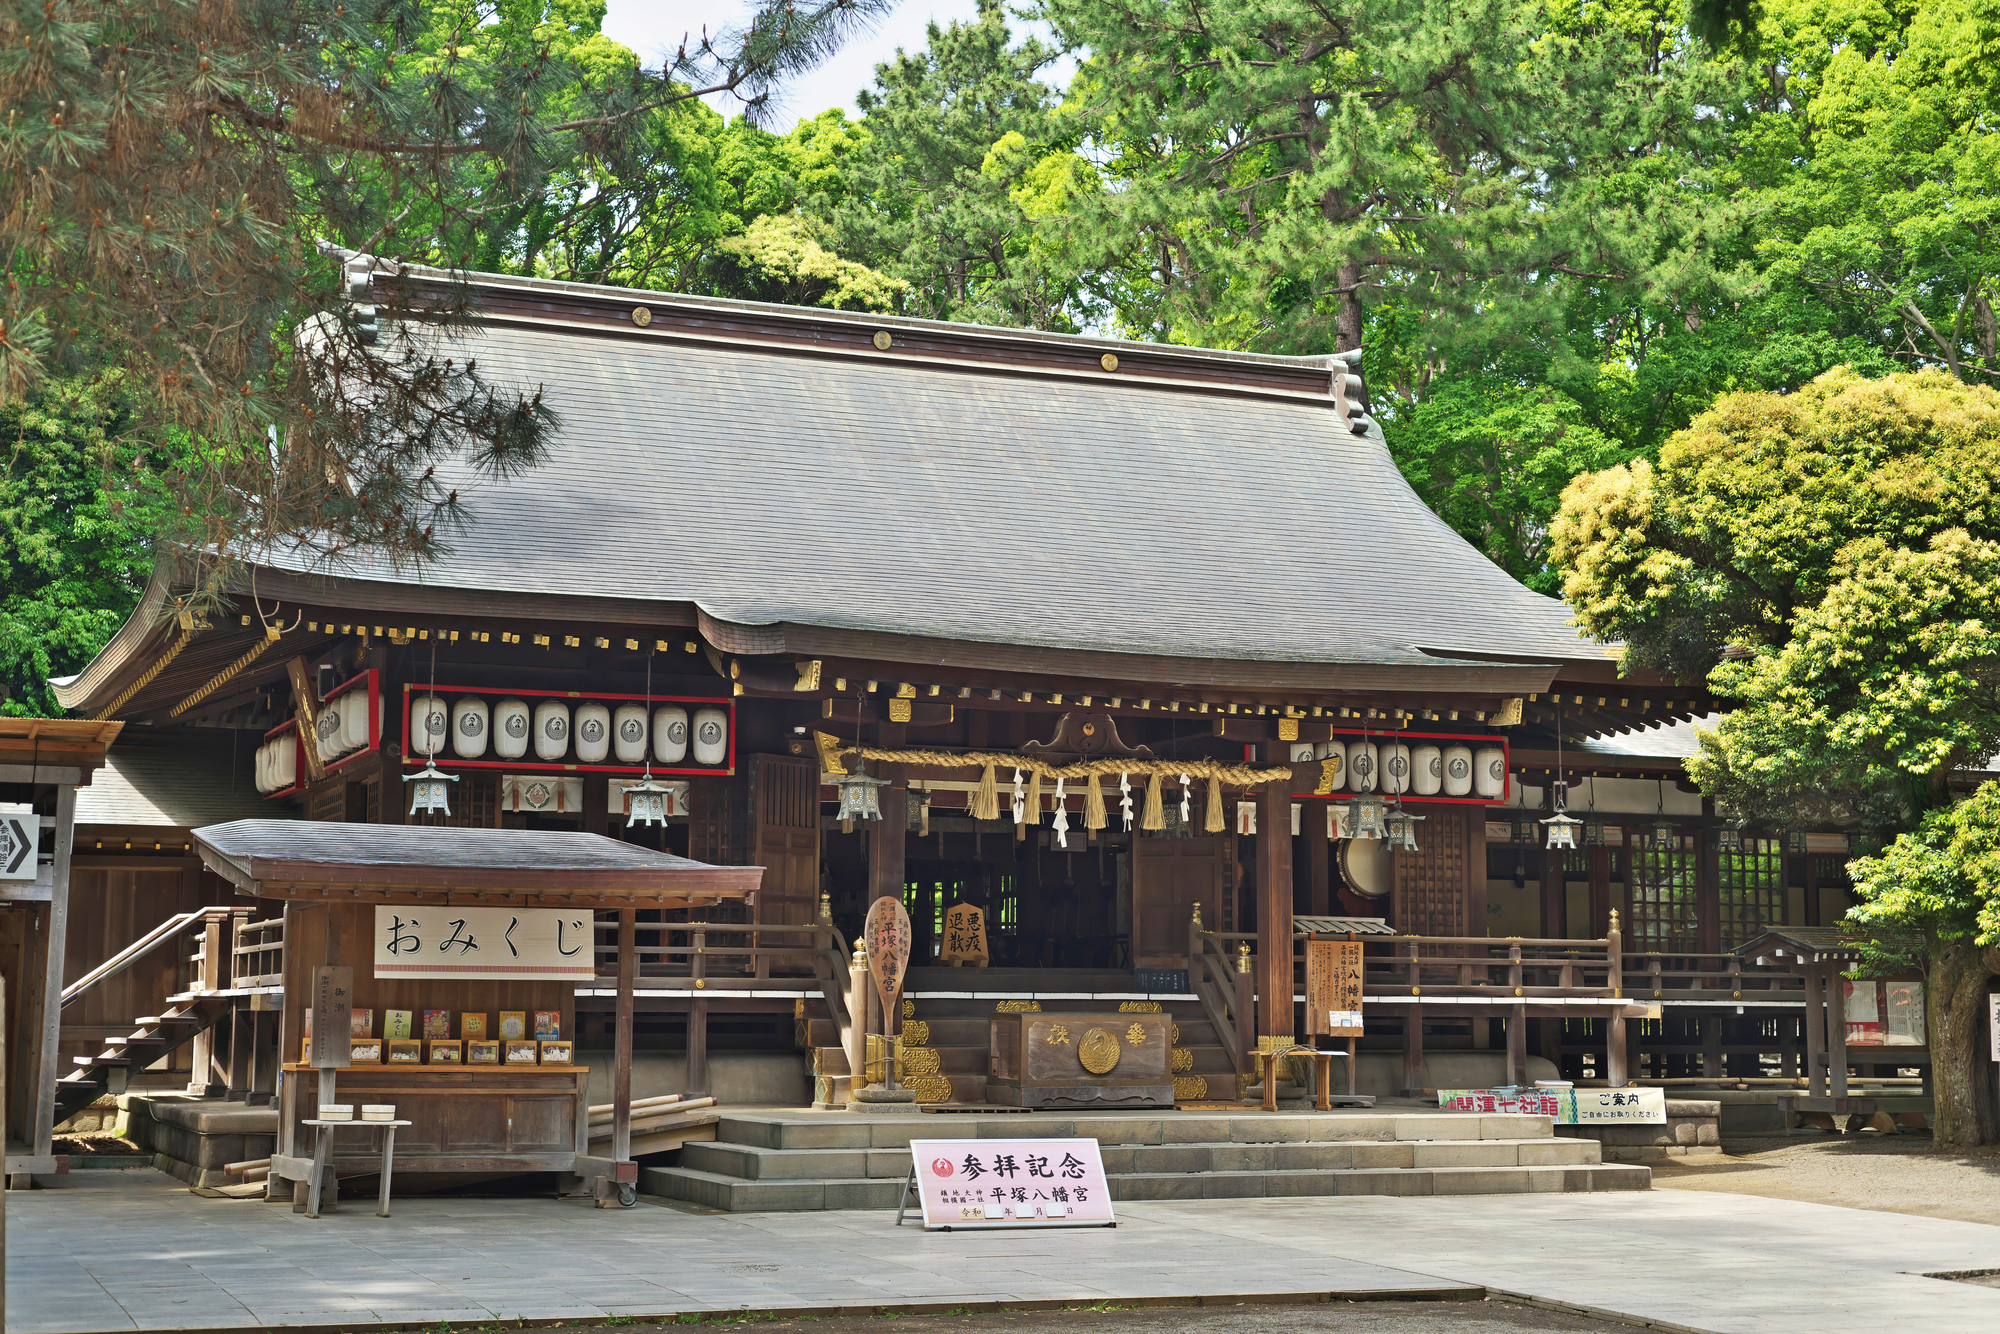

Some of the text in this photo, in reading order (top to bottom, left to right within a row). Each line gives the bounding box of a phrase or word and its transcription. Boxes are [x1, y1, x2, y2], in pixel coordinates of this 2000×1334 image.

[386, 914, 585, 958] おみくじ
[949, 912, 964, 952] 退散
[966, 912, 981, 952] 悪疫
[881, 922, 898, 992] 平塚八幡宮
[1347, 969, 1360, 1011] 八幡宮
[394, 1012, 403, 1036] おみくじ
[1599, 1092, 1639, 1106] ご案内
[1581, 1111, 1659, 1119] ご自由にお取りください
[960, 1152, 1086, 1181] 参拝記念
[990, 1186, 1089, 1204] 平塚八幡宮
[961, 1207, 1074, 1217] 令和 年 月 日
